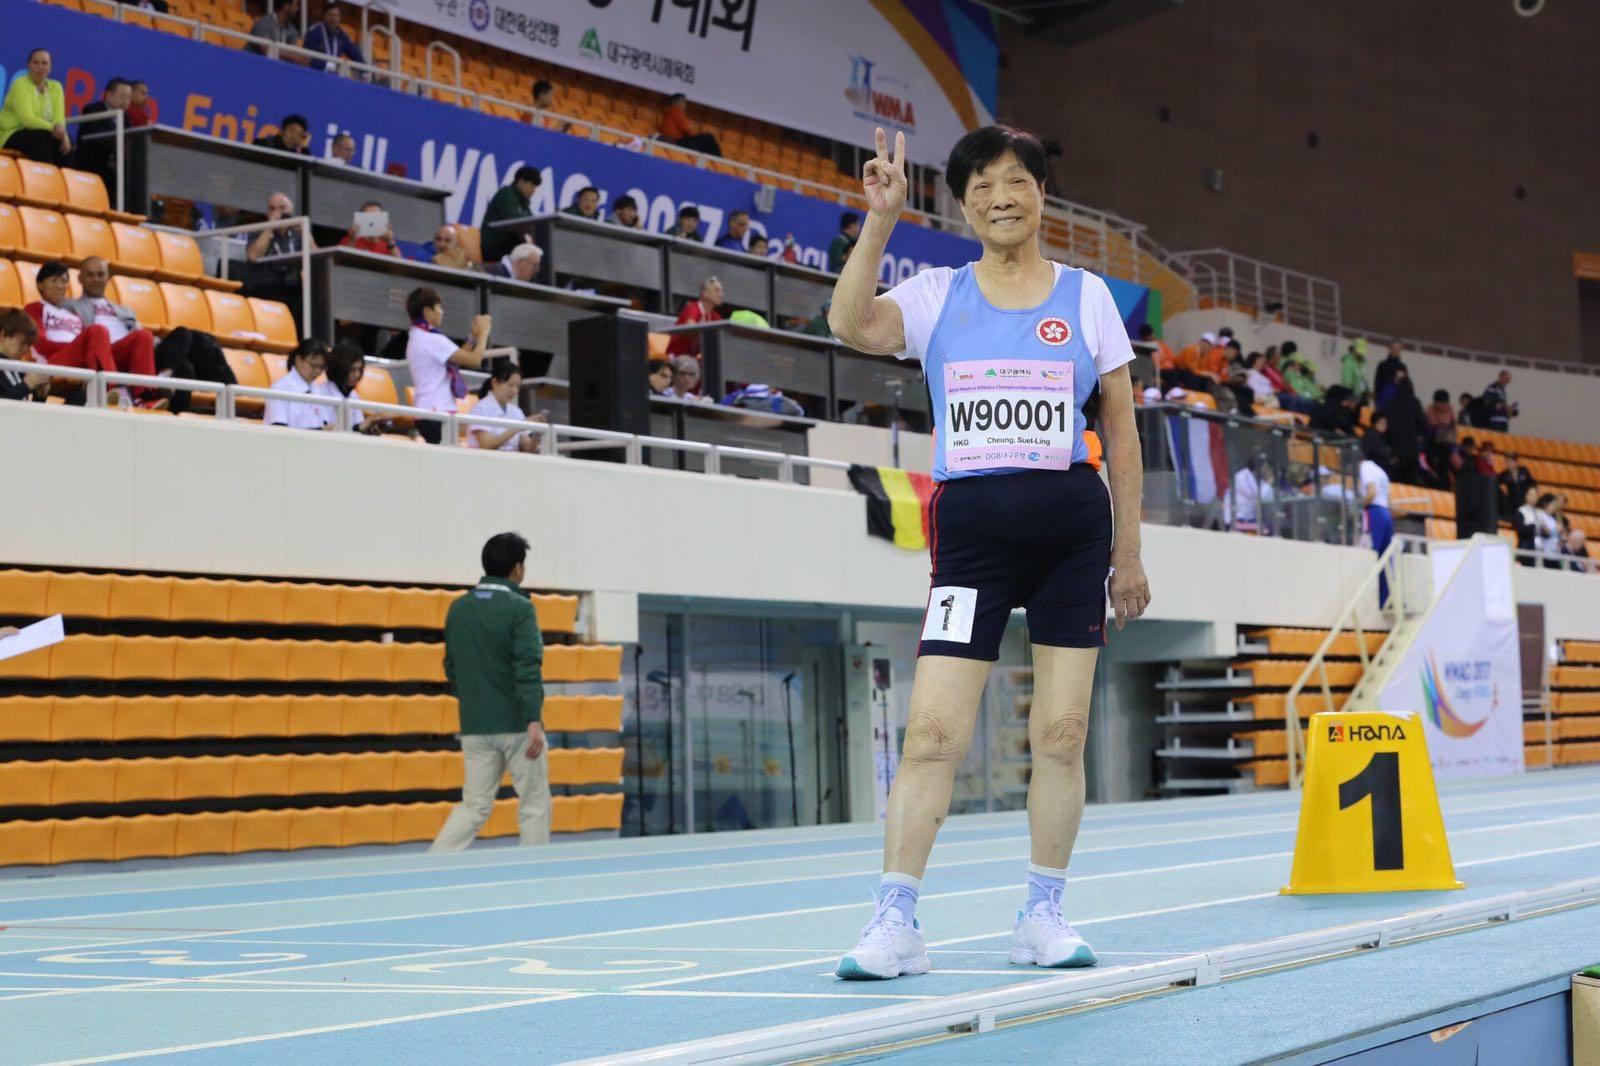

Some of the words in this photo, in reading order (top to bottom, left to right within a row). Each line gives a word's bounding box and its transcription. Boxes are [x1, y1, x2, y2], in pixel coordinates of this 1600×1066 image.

[950, 399, 1065, 433] W90001
[953, 439, 969, 447] HKG
[1017, 436, 1051, 447] Suet-Ling
[1338, 751, 1405, 871] 1
